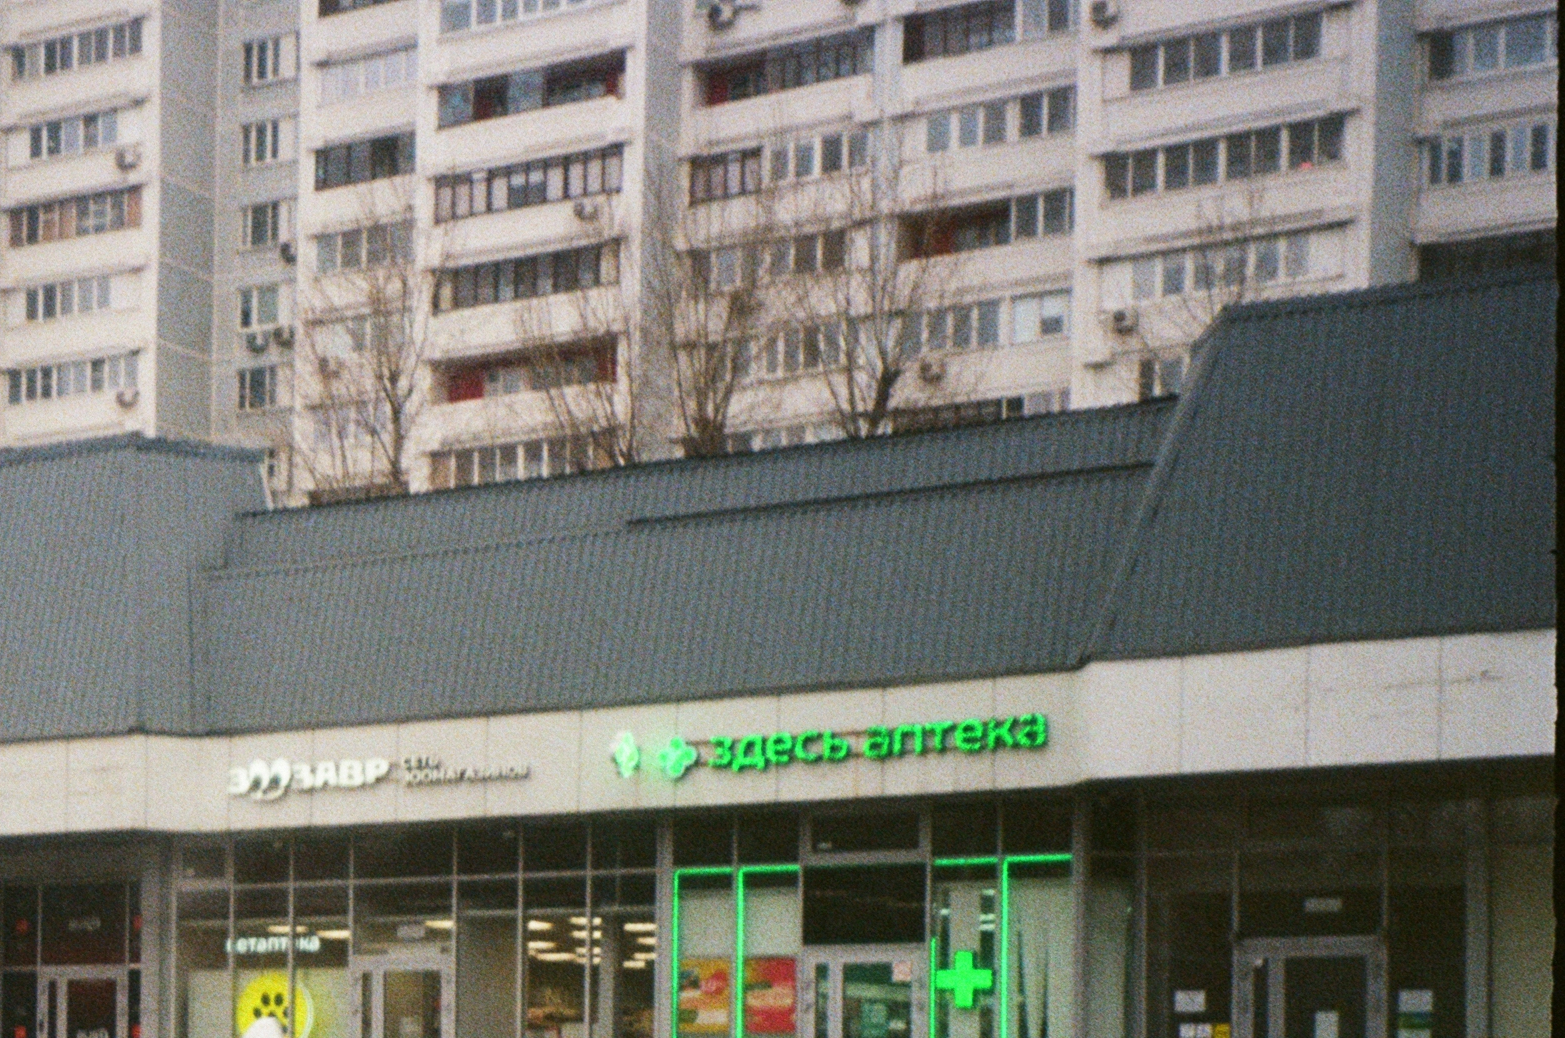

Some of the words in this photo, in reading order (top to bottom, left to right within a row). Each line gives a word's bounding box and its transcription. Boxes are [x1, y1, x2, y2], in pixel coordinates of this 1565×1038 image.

[707, 730, 851, 773] здесь
[862, 712, 1048, 761] аптека
[225, 935, 321, 953] етаптка
